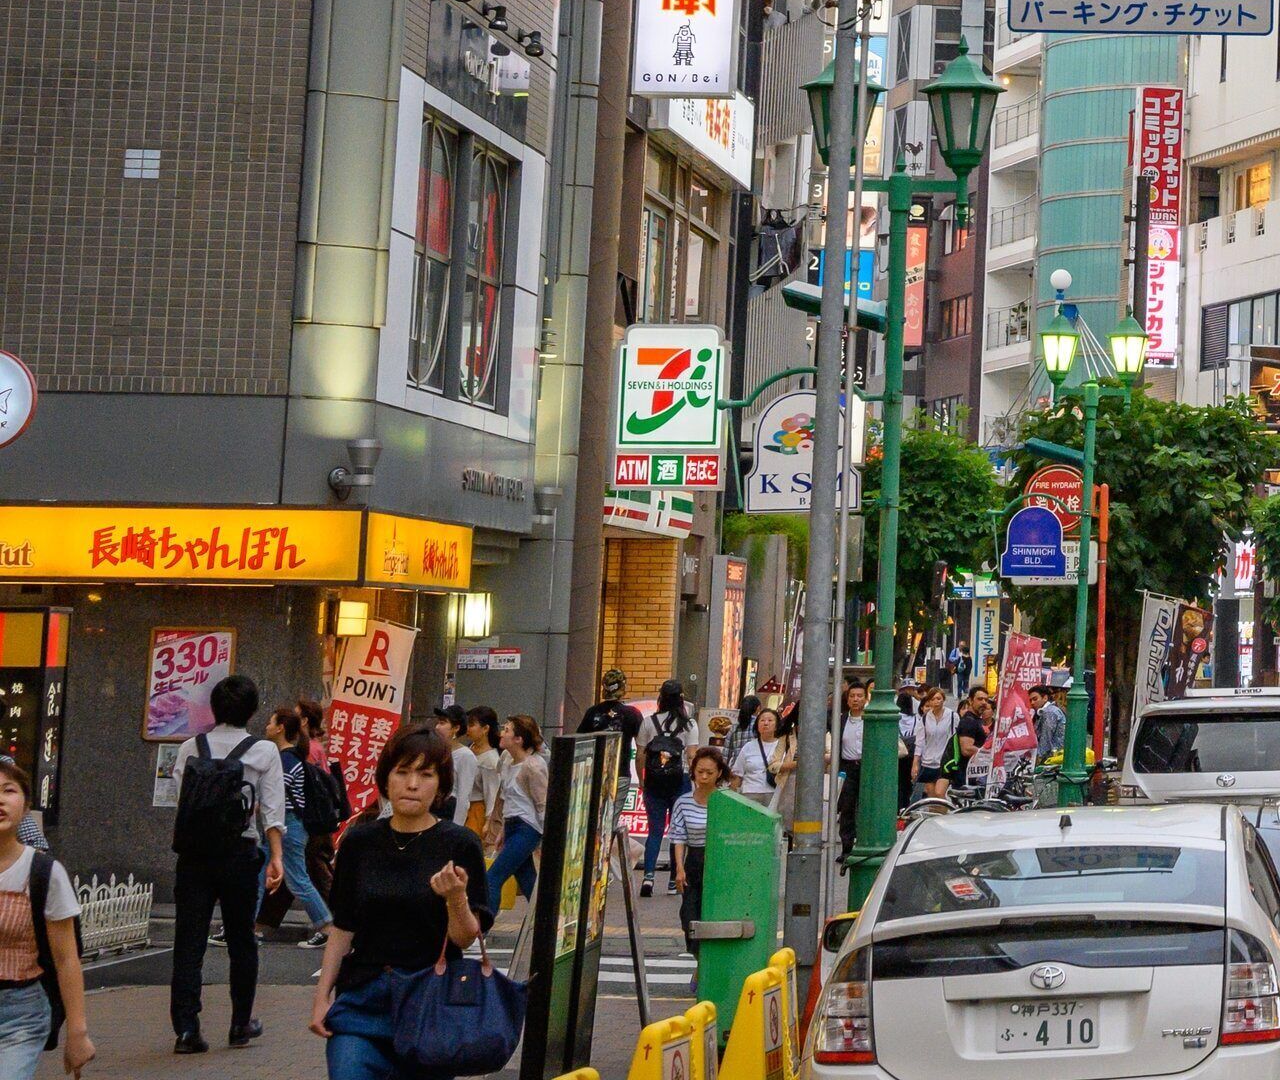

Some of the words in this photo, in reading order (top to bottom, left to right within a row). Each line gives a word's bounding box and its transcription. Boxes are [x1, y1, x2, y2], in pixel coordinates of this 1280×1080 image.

[1021, 0, 1257, 26] パーキング・チケット
[1142, 97, 1161, 163] コミック
[1162, 91, 1181, 207] インターネット
[813, 184, 823, 198] 3
[809, 256, 819, 270] 2
[1146, 262, 1165, 350] ジャンカラ
[805, 326, 814, 341] 2
[667, 380, 713, 391] HOLDINGS
[617, 460, 648, 481] ATM
[657, 459, 677, 481] 酒
[686, 461, 718, 481] たばこ
[1035, 481, 1050, 490] FIRE
[1051, 481, 1082, 490] HYDRANT
[1035, 494, 1081, 515] 消火栓
[88, 525, 306, 571] 長崎ちゃんぽん
[1012, 546, 1056, 557] SHINMICHI
[1024, 556, 1043, 565] BLD.
[154, 635, 219, 680] 330
[154, 670, 209, 695] 生ビール
[342, 675, 397, 704] POINT
[1161, 1026, 1213, 1039] PRIUS
